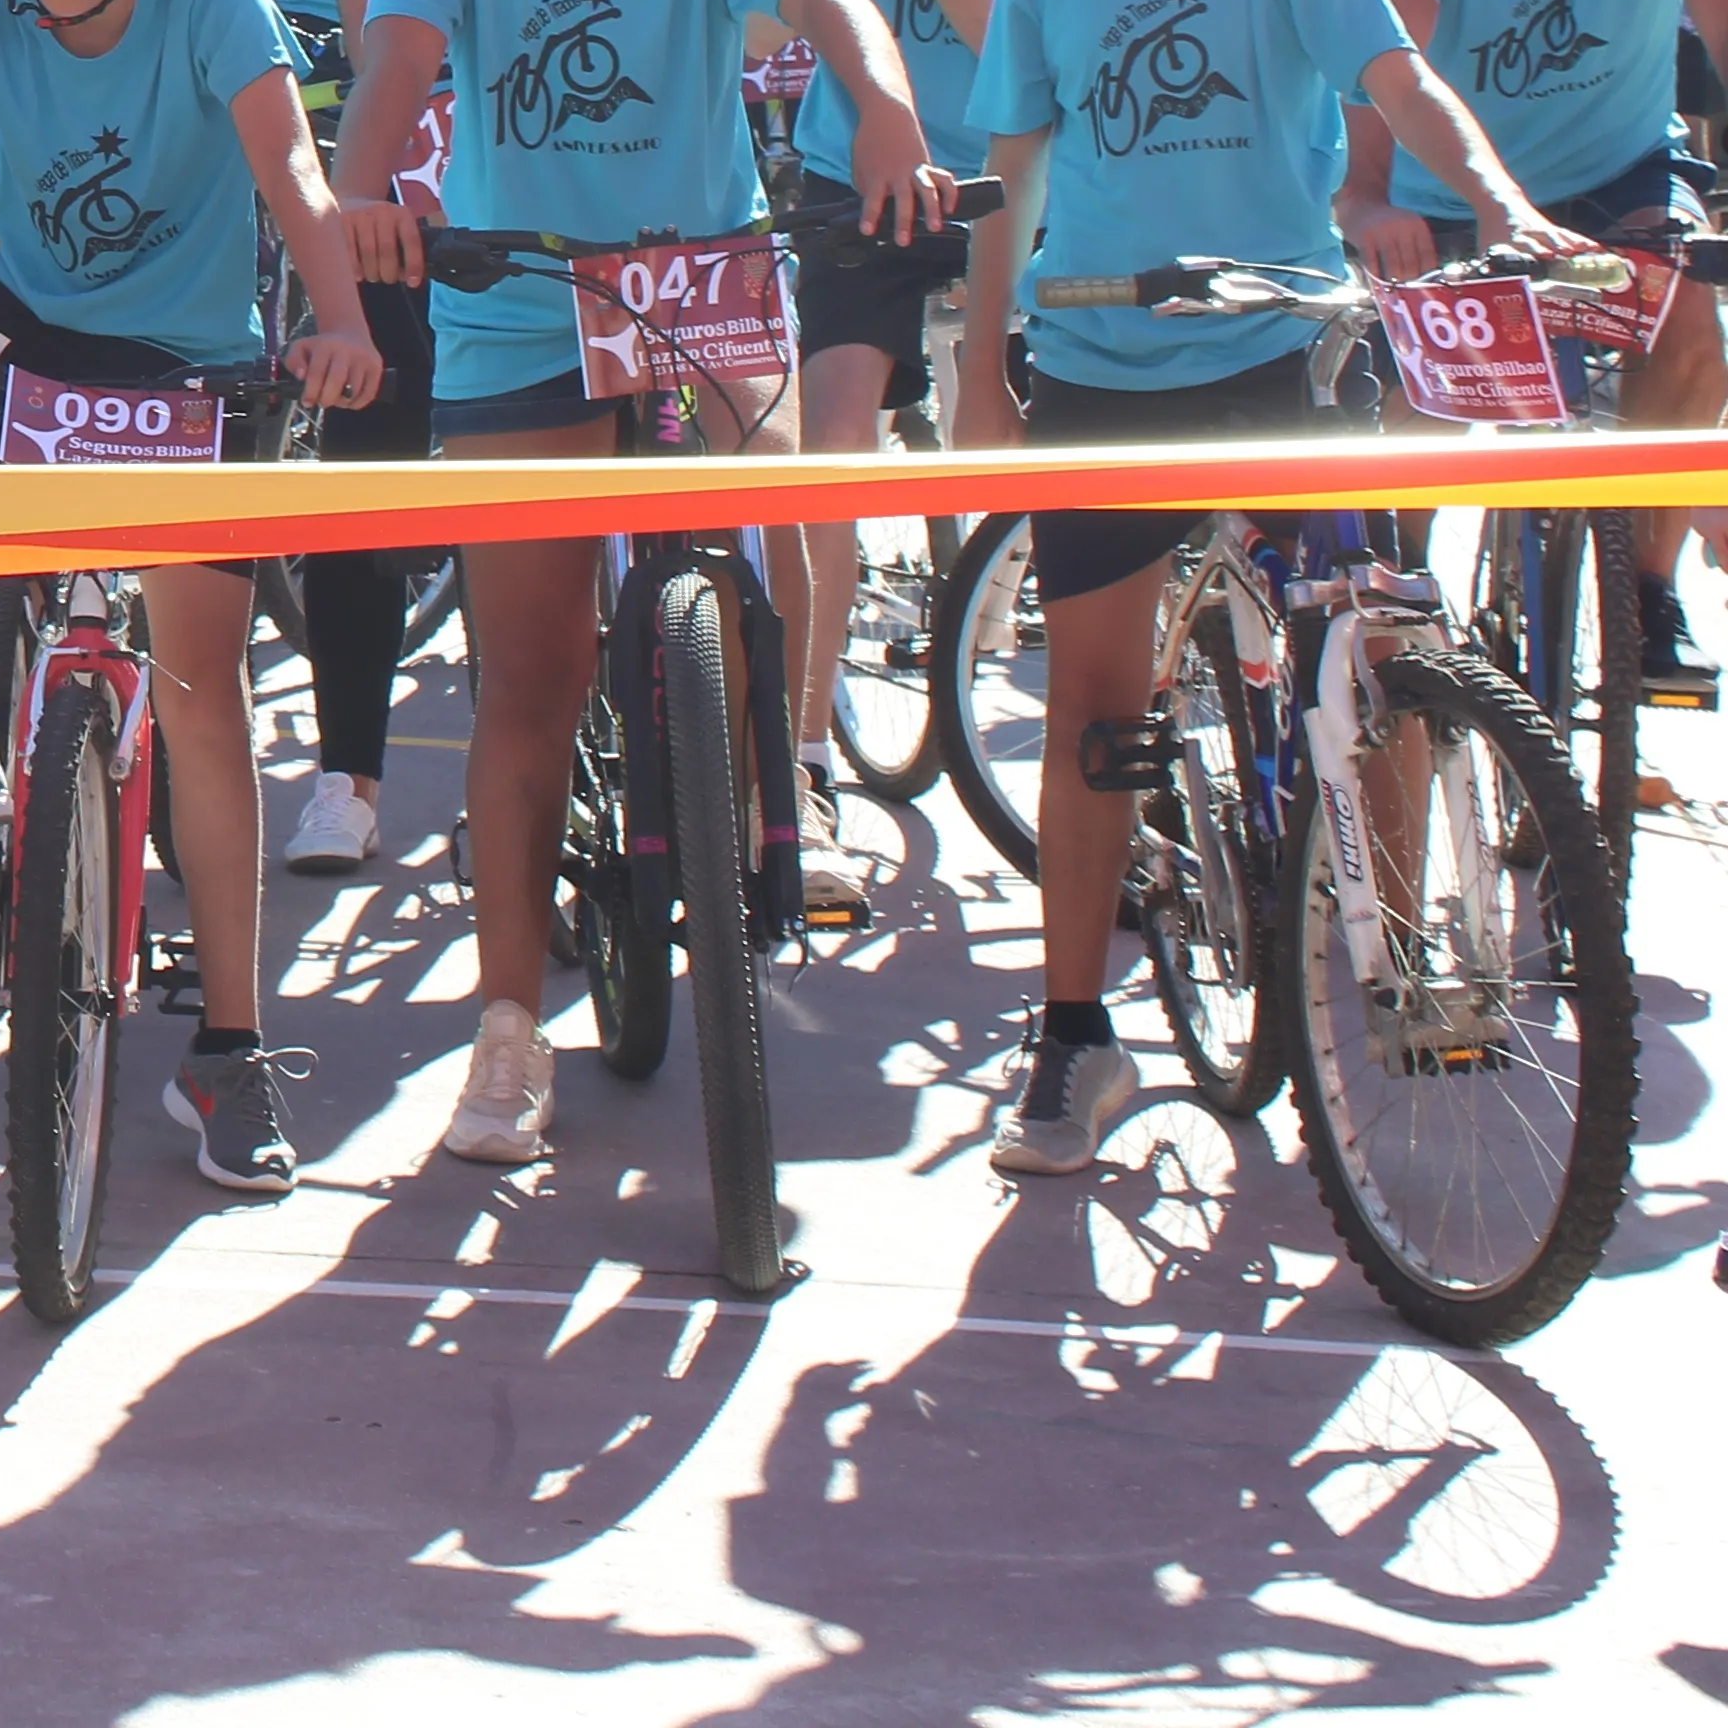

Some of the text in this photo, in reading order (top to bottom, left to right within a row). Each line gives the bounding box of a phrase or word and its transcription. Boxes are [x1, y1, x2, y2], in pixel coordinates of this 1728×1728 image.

[620, 251, 730, 314] 047
[1393, 298, 1496, 350] 168
[54, 392, 172, 436] 090
